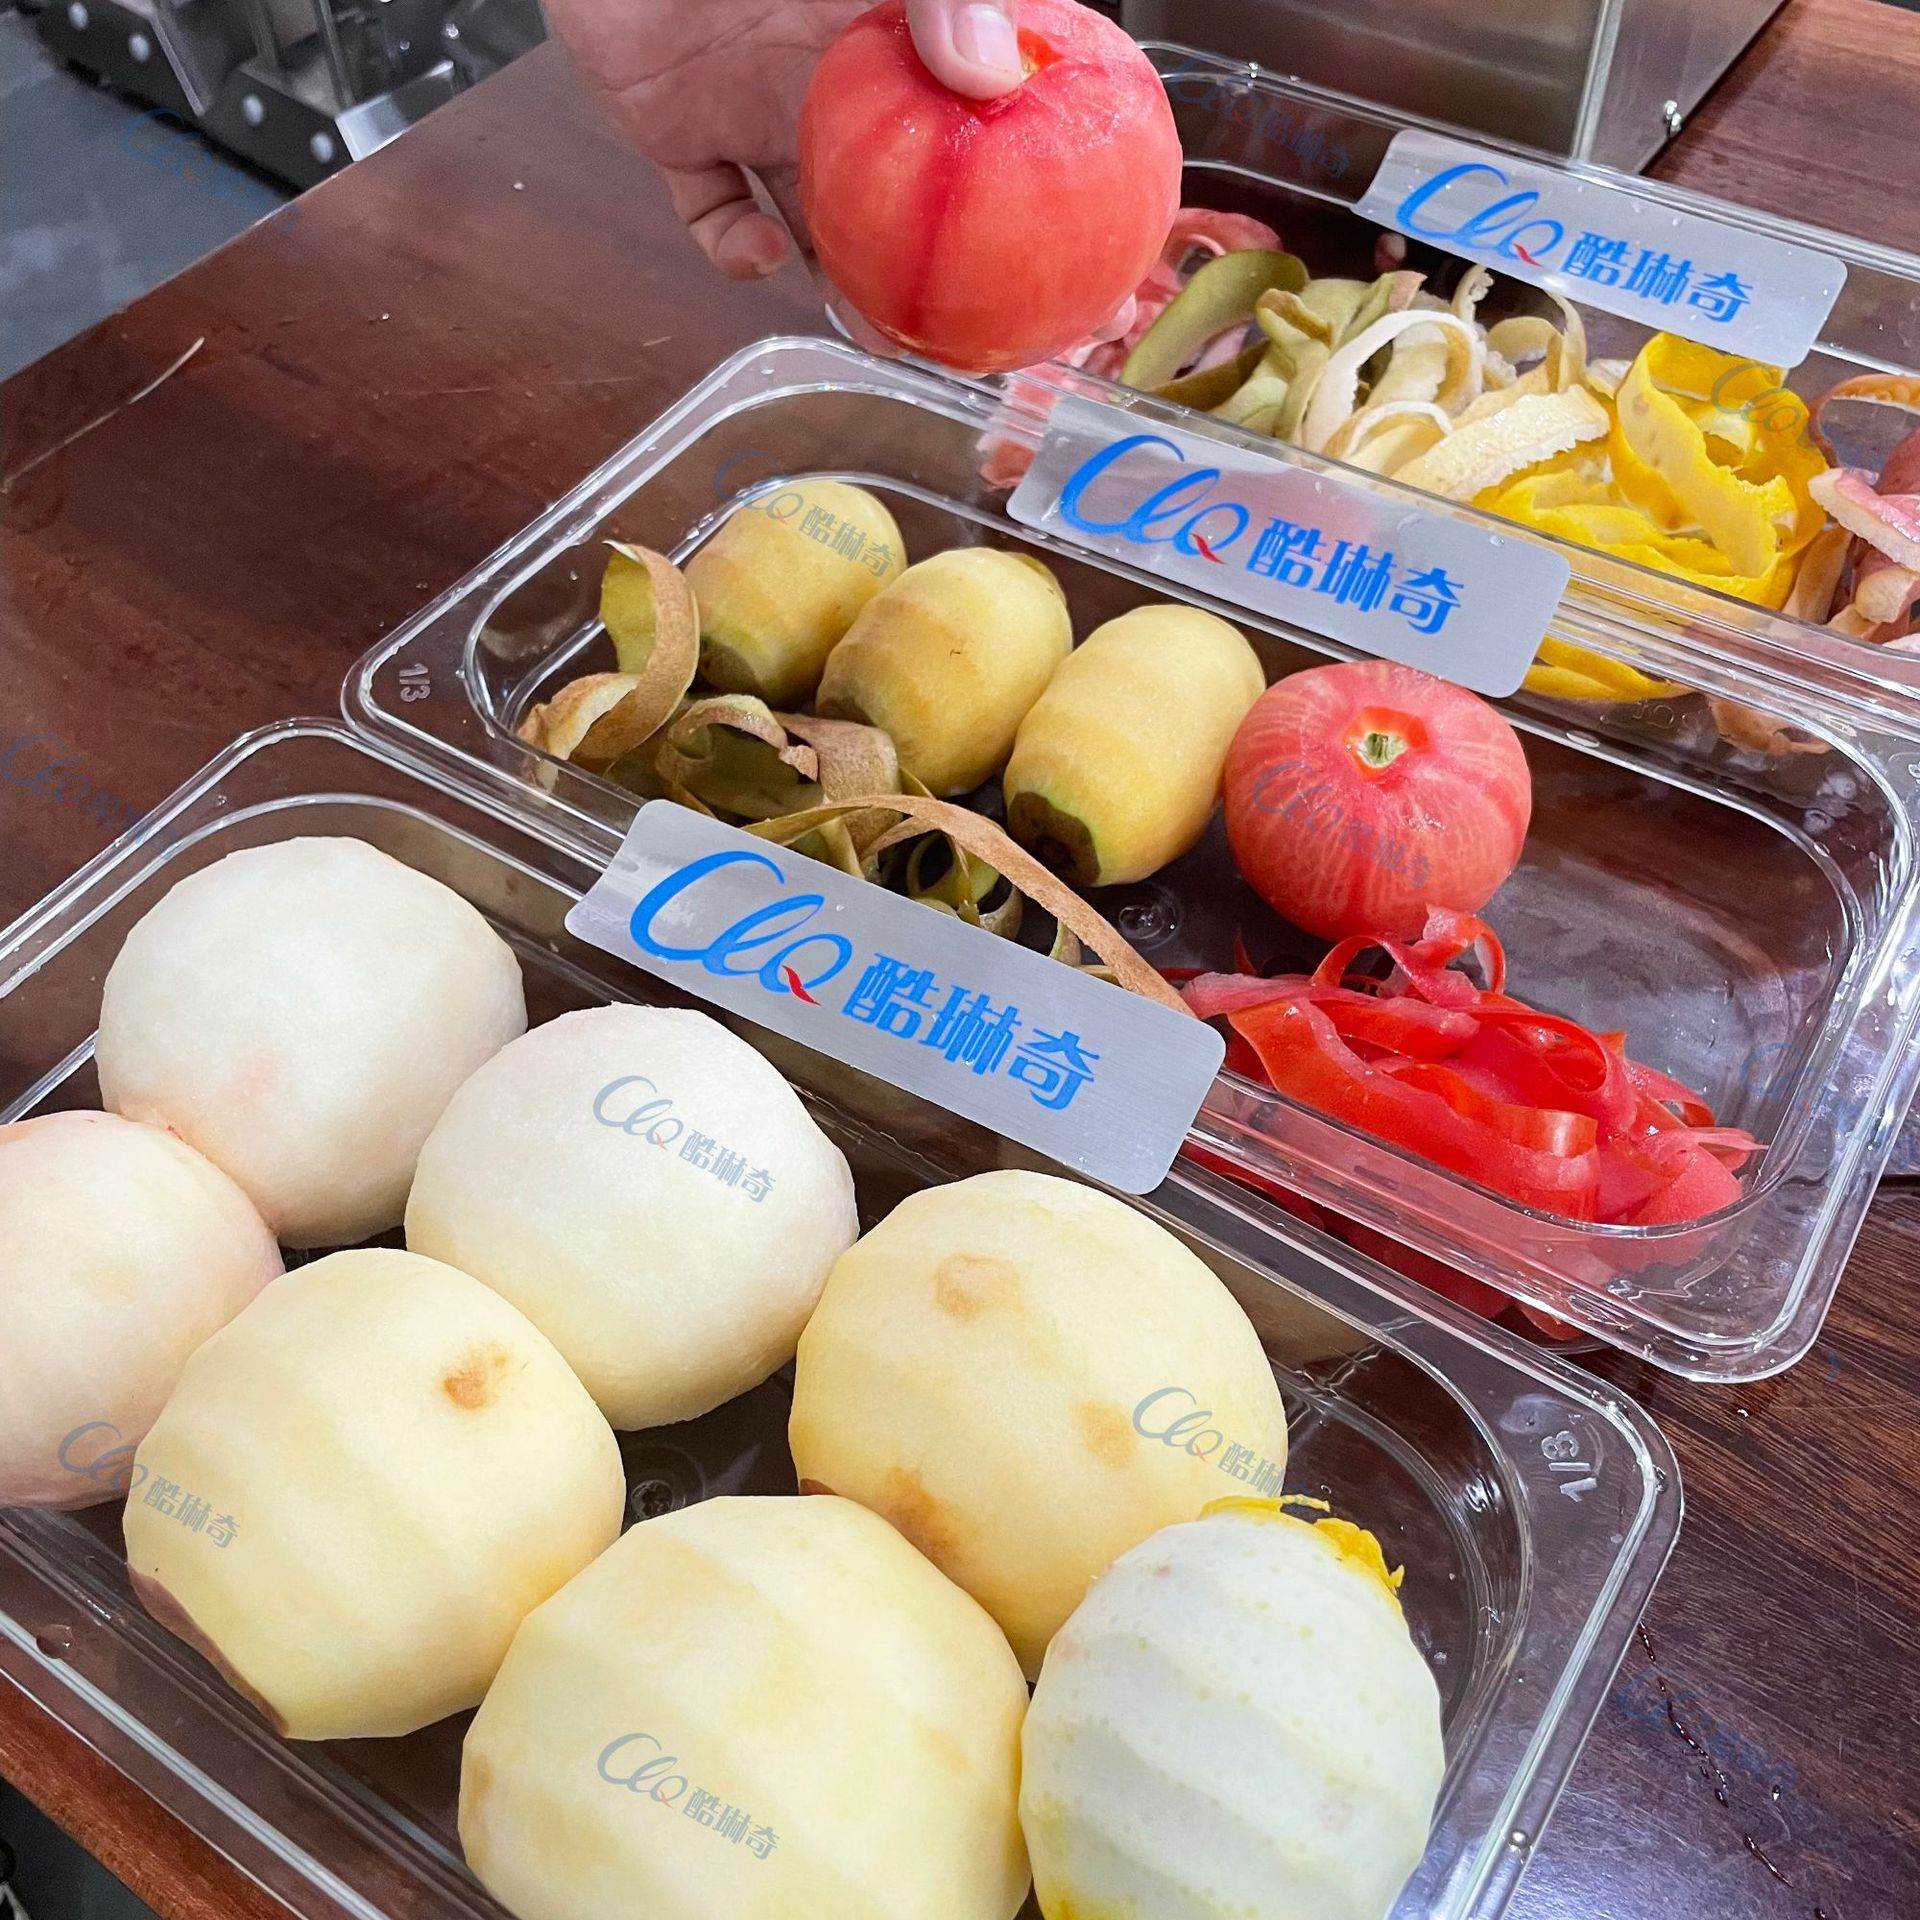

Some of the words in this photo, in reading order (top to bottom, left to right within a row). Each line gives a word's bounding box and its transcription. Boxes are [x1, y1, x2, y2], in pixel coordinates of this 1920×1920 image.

[1560, 231, 1754, 323] 酷琳奇
[1246, 516, 1465, 635] 酷琳奇
[400, 662, 431, 702] 1/3
[842, 952, 1101, 1111] 酷琳奇
[1541, 1430, 1598, 1502] 1/3
